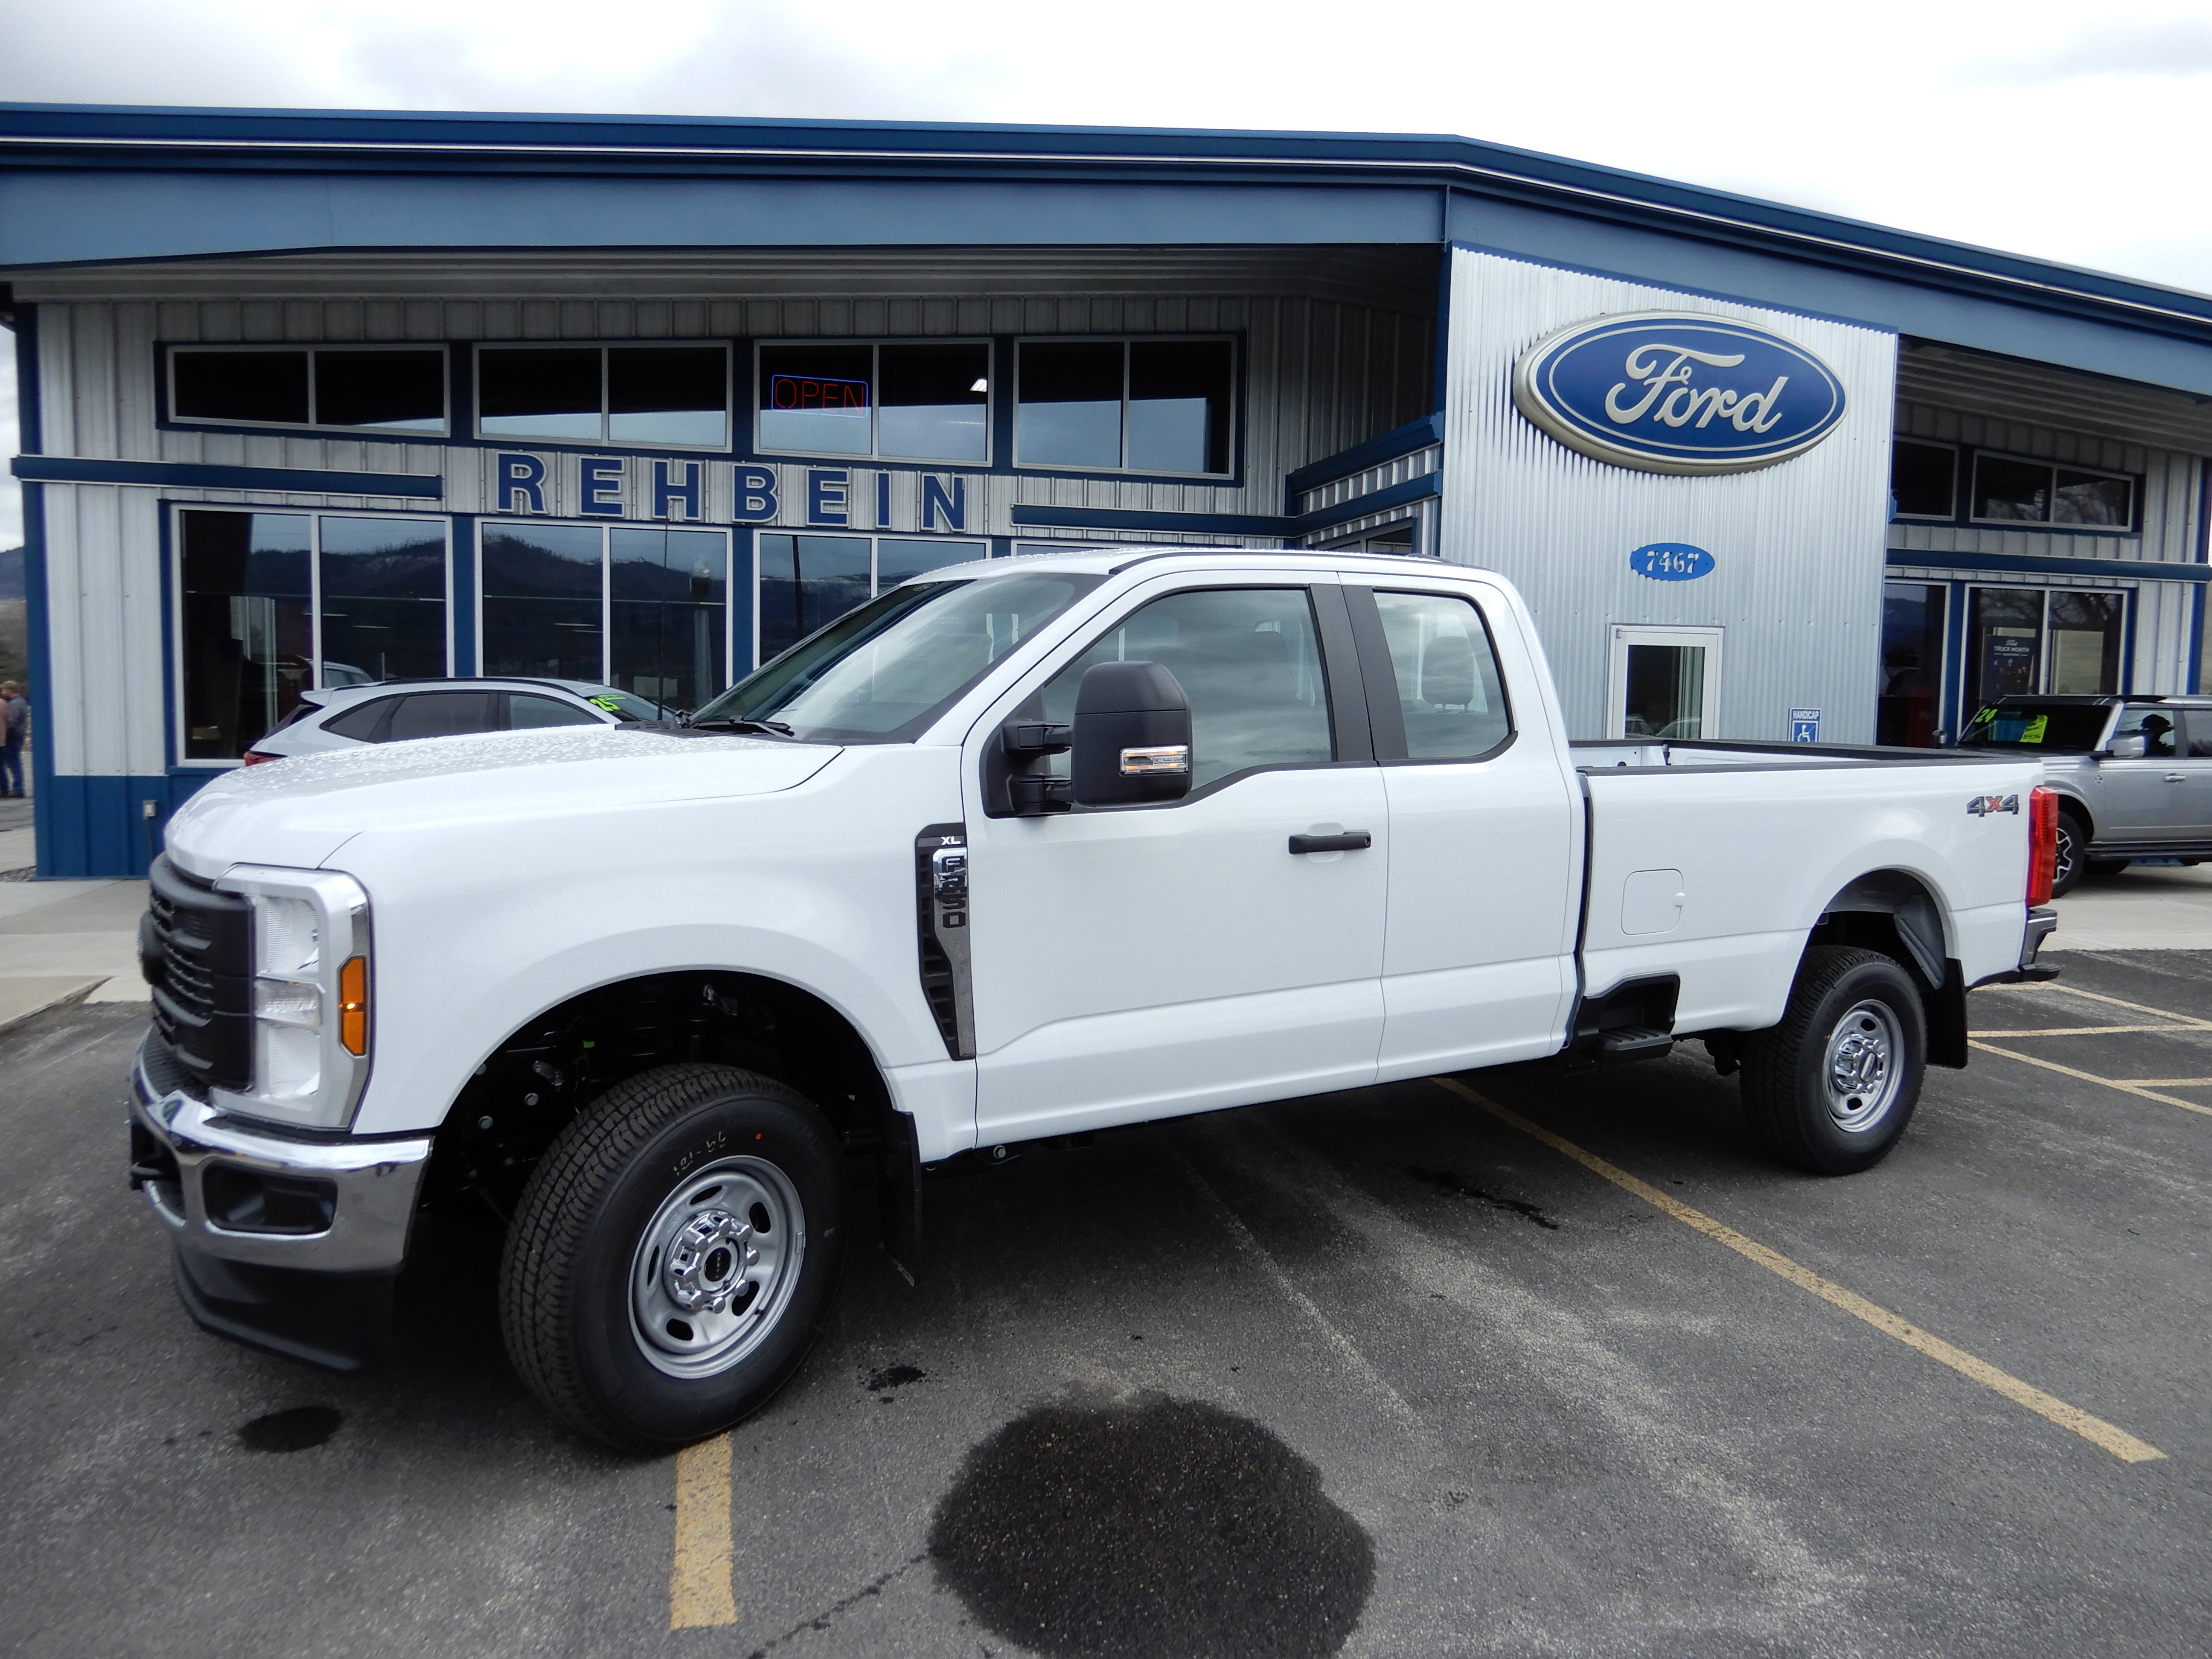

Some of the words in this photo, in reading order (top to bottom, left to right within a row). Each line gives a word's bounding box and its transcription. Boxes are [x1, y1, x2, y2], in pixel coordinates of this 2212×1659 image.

[775, 379, 864, 415] OPEN
[1605, 343, 1789, 434] Ford
[496, 451, 966, 533] REHBEIN
[1647, 551, 1699, 573] 7467
[1793, 710, 1819, 719] HANDICAP
[941, 836, 961, 845] XL
